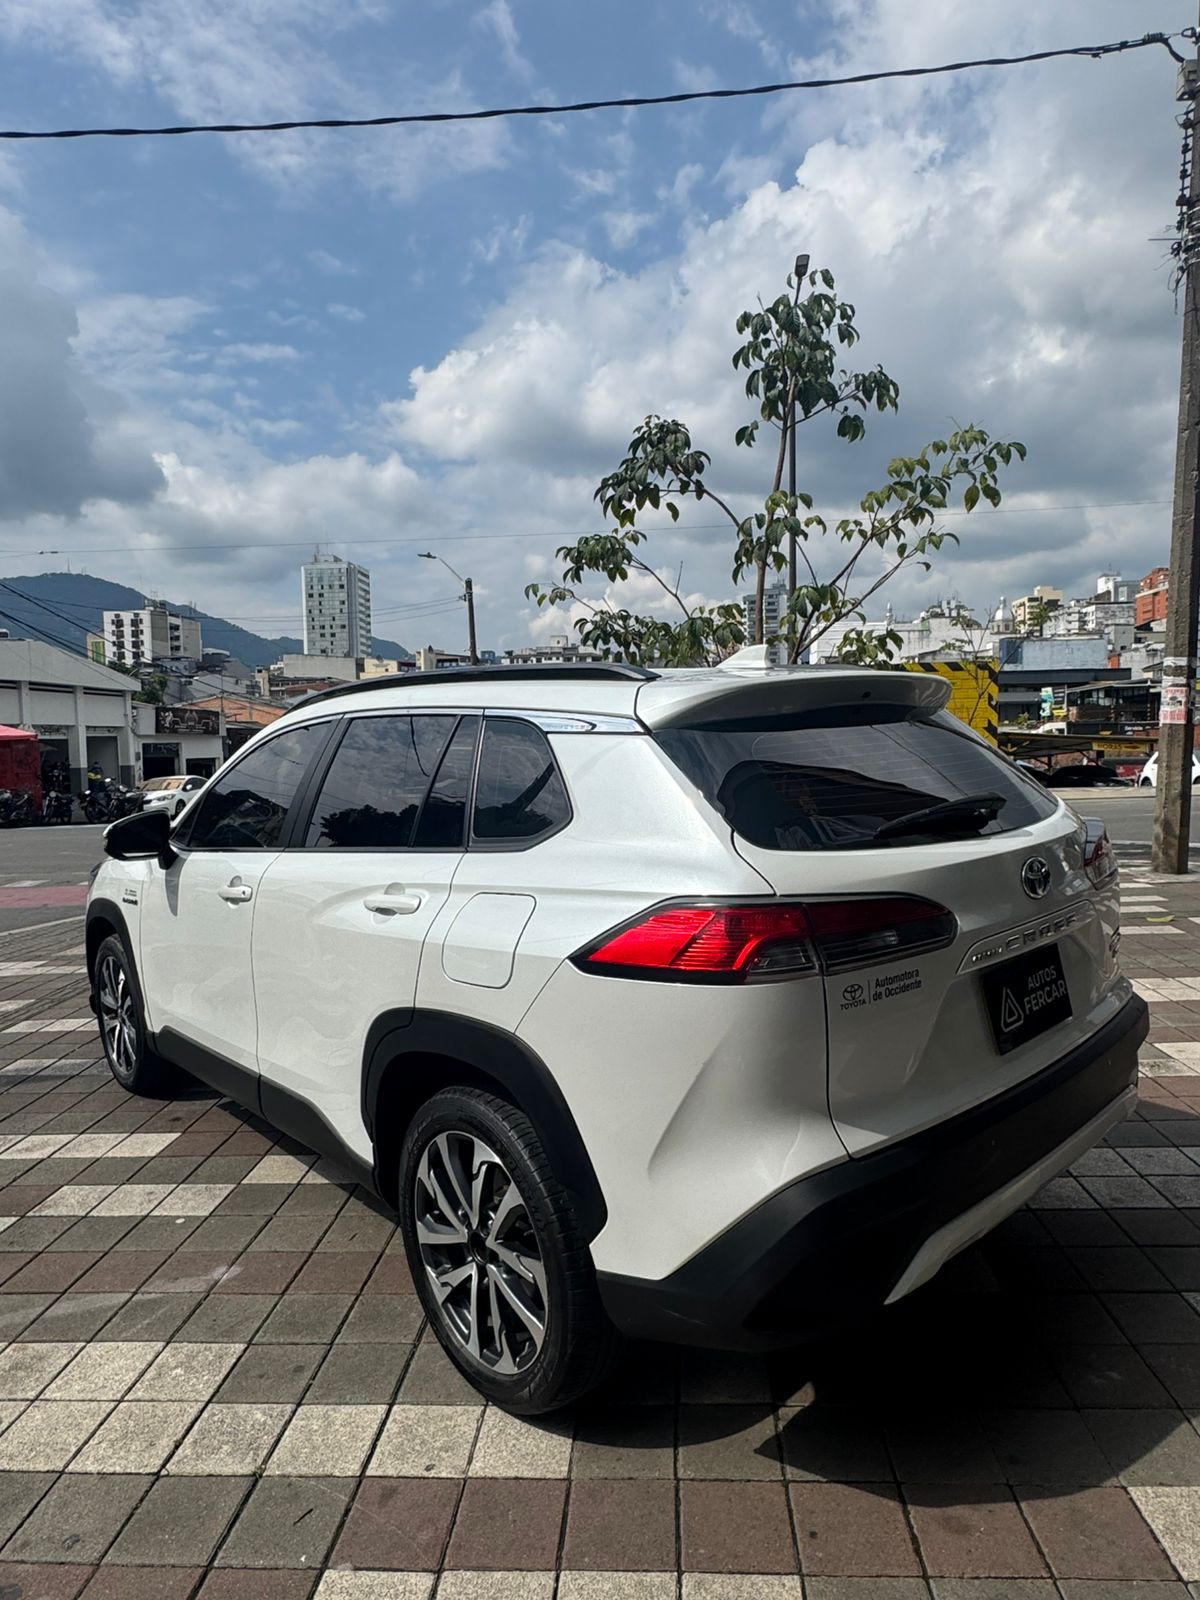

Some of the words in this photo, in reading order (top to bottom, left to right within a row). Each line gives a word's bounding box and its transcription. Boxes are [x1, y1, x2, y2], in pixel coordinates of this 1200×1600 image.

[875, 968, 920, 989] Automotora
[1028, 965, 1057, 991] AUTOS
[872, 990, 883, 1002] de
[884, 979, 922, 998] Occidente
[1023, 980, 1067, 1015] FERCAR
[840, 999, 867, 1011] TOYOTA
